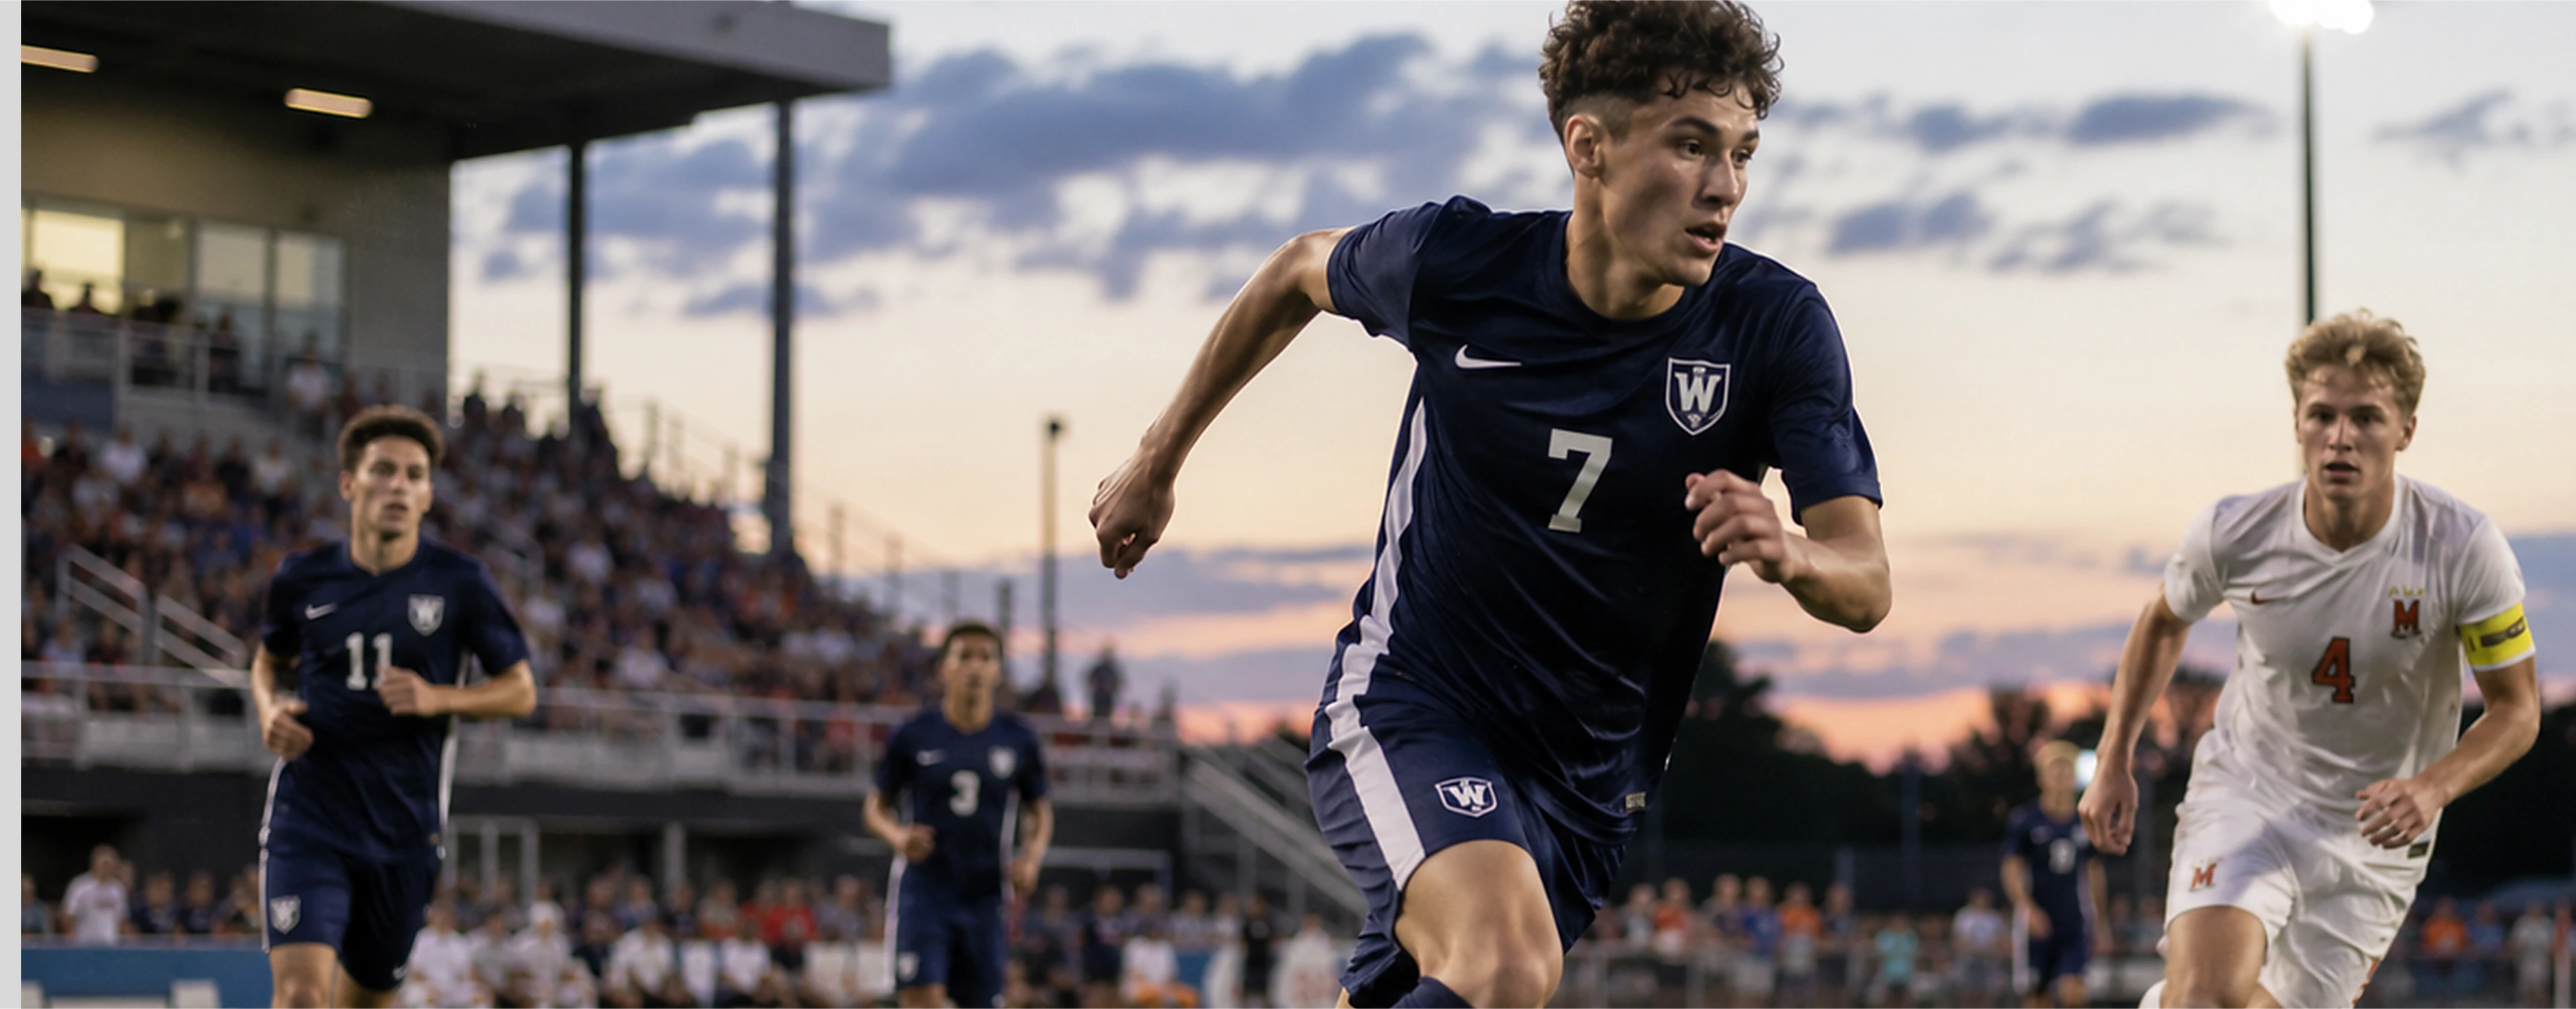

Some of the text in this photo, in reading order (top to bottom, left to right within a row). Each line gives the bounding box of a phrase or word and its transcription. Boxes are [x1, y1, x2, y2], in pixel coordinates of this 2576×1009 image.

[1674, 372, 1721, 413] W
[1548, 428, 1612, 533] 7
[2392, 598, 2421, 637] M
[345, 632, 393, 690] 11
[2312, 636, 2355, 703] 4
[949, 769, 981, 816] 3
[1443, 784, 1487, 807] W
[2189, 862, 2217, 892] M
